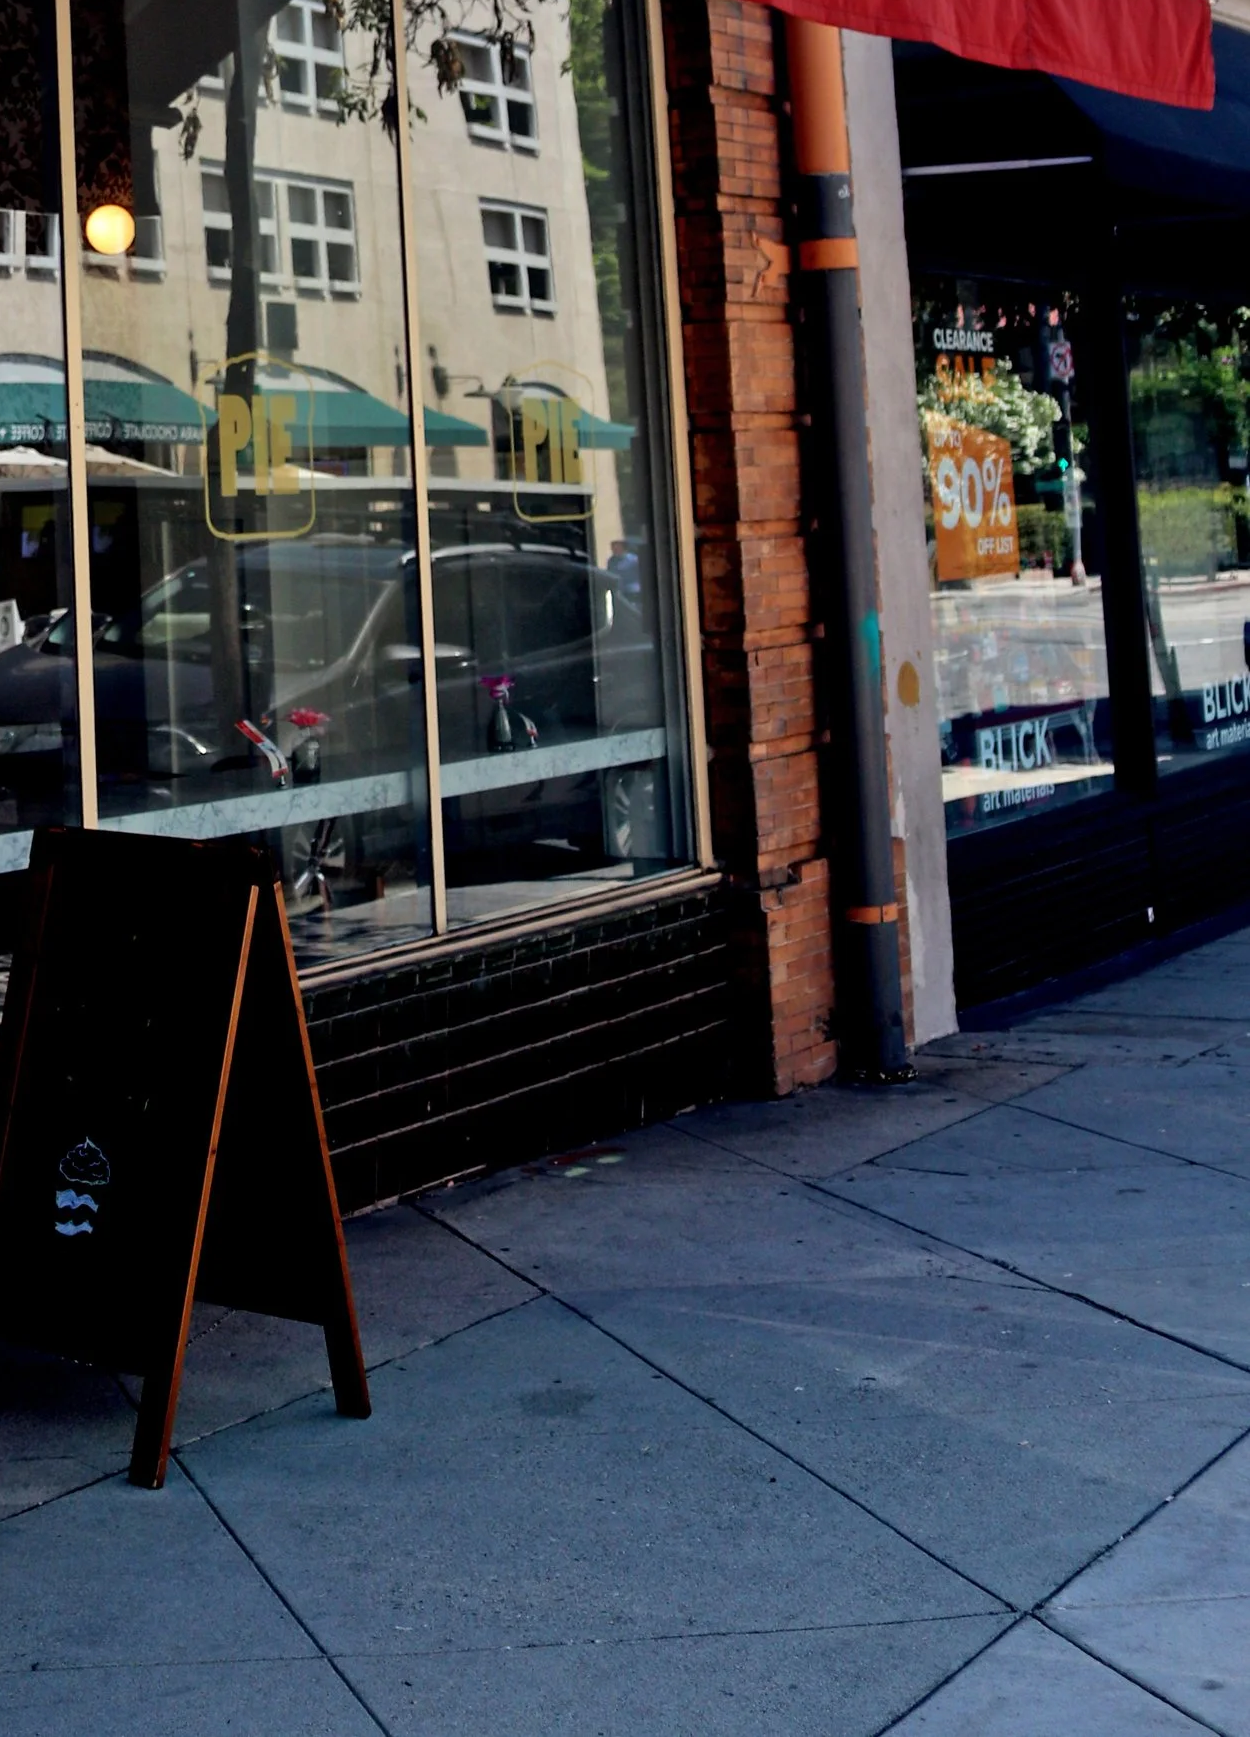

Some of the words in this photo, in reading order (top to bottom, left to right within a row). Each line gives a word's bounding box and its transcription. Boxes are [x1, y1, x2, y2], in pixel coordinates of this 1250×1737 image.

[933, 328, 994, 354] CLEARANCE
[219, 394, 301, 498] PIE
[521, 397, 585, 485] PIE
[937, 457, 1012, 530] 90%
[979, 717, 1052, 772] BLICK
[1206, 728, 1220, 750] art
[982, 789, 1001, 813] art
